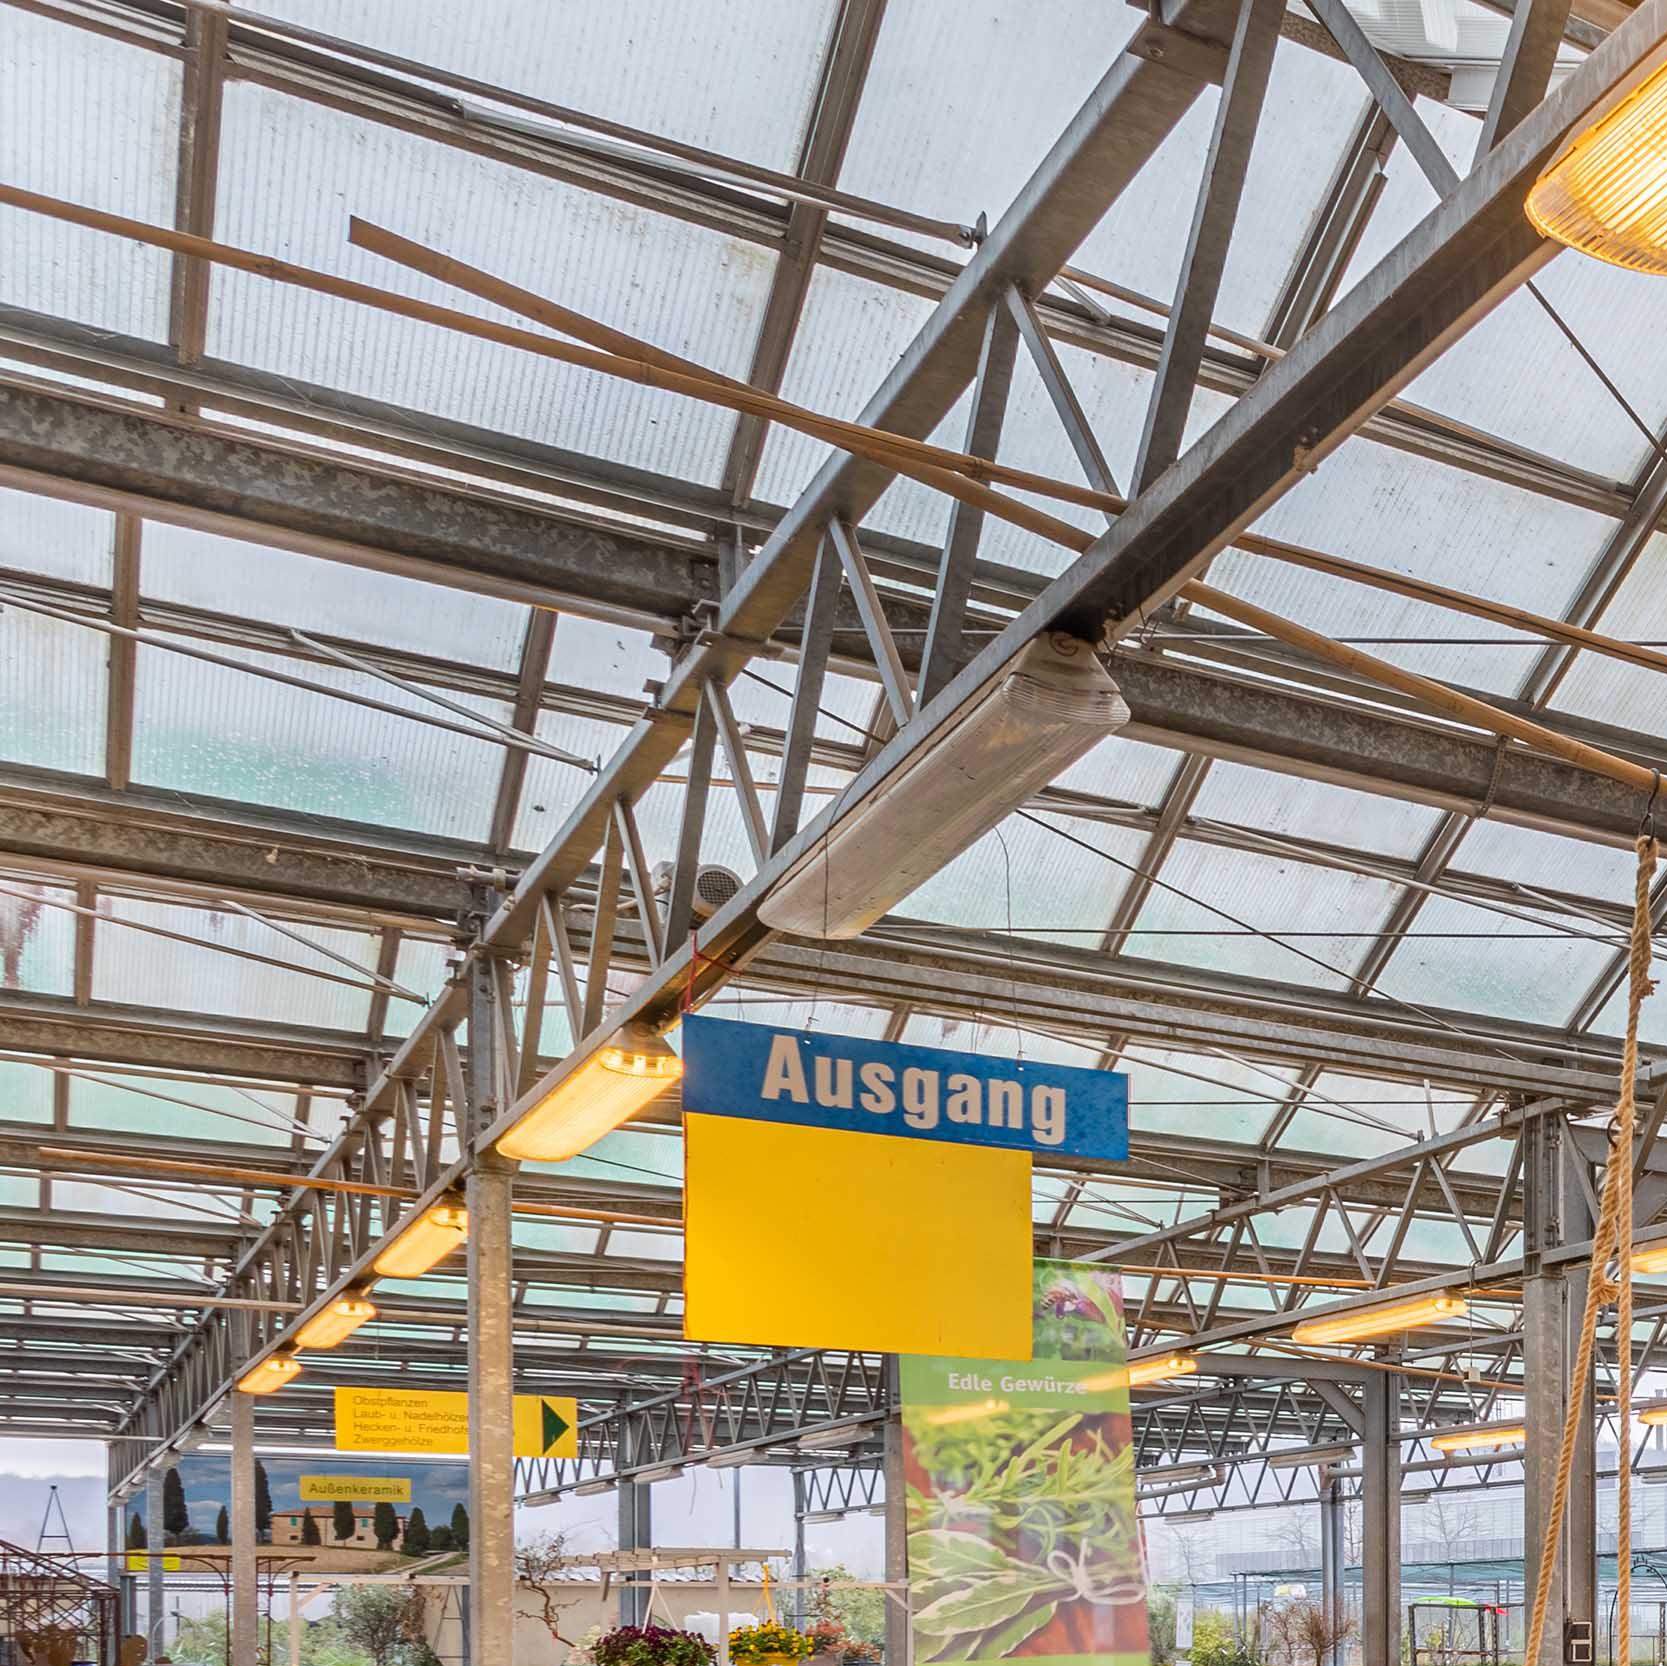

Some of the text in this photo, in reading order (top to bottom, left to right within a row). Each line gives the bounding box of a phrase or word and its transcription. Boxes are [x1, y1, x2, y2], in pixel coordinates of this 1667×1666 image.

[761, 1034, 1066, 1146] Ausgang
[948, 1373, 1088, 1395] Edle Gewürze
[353, 1396, 428, 1408] Obstpflanzen
[353, 1409, 386, 1419] Laub-
[403, 1411, 469, 1422] Nadelhölze
[353, 1422, 400, 1433] Hecken-
[352, 1434, 433, 1447] Zwerggehölze
[308, 1481, 404, 1496] Außenkeramik
